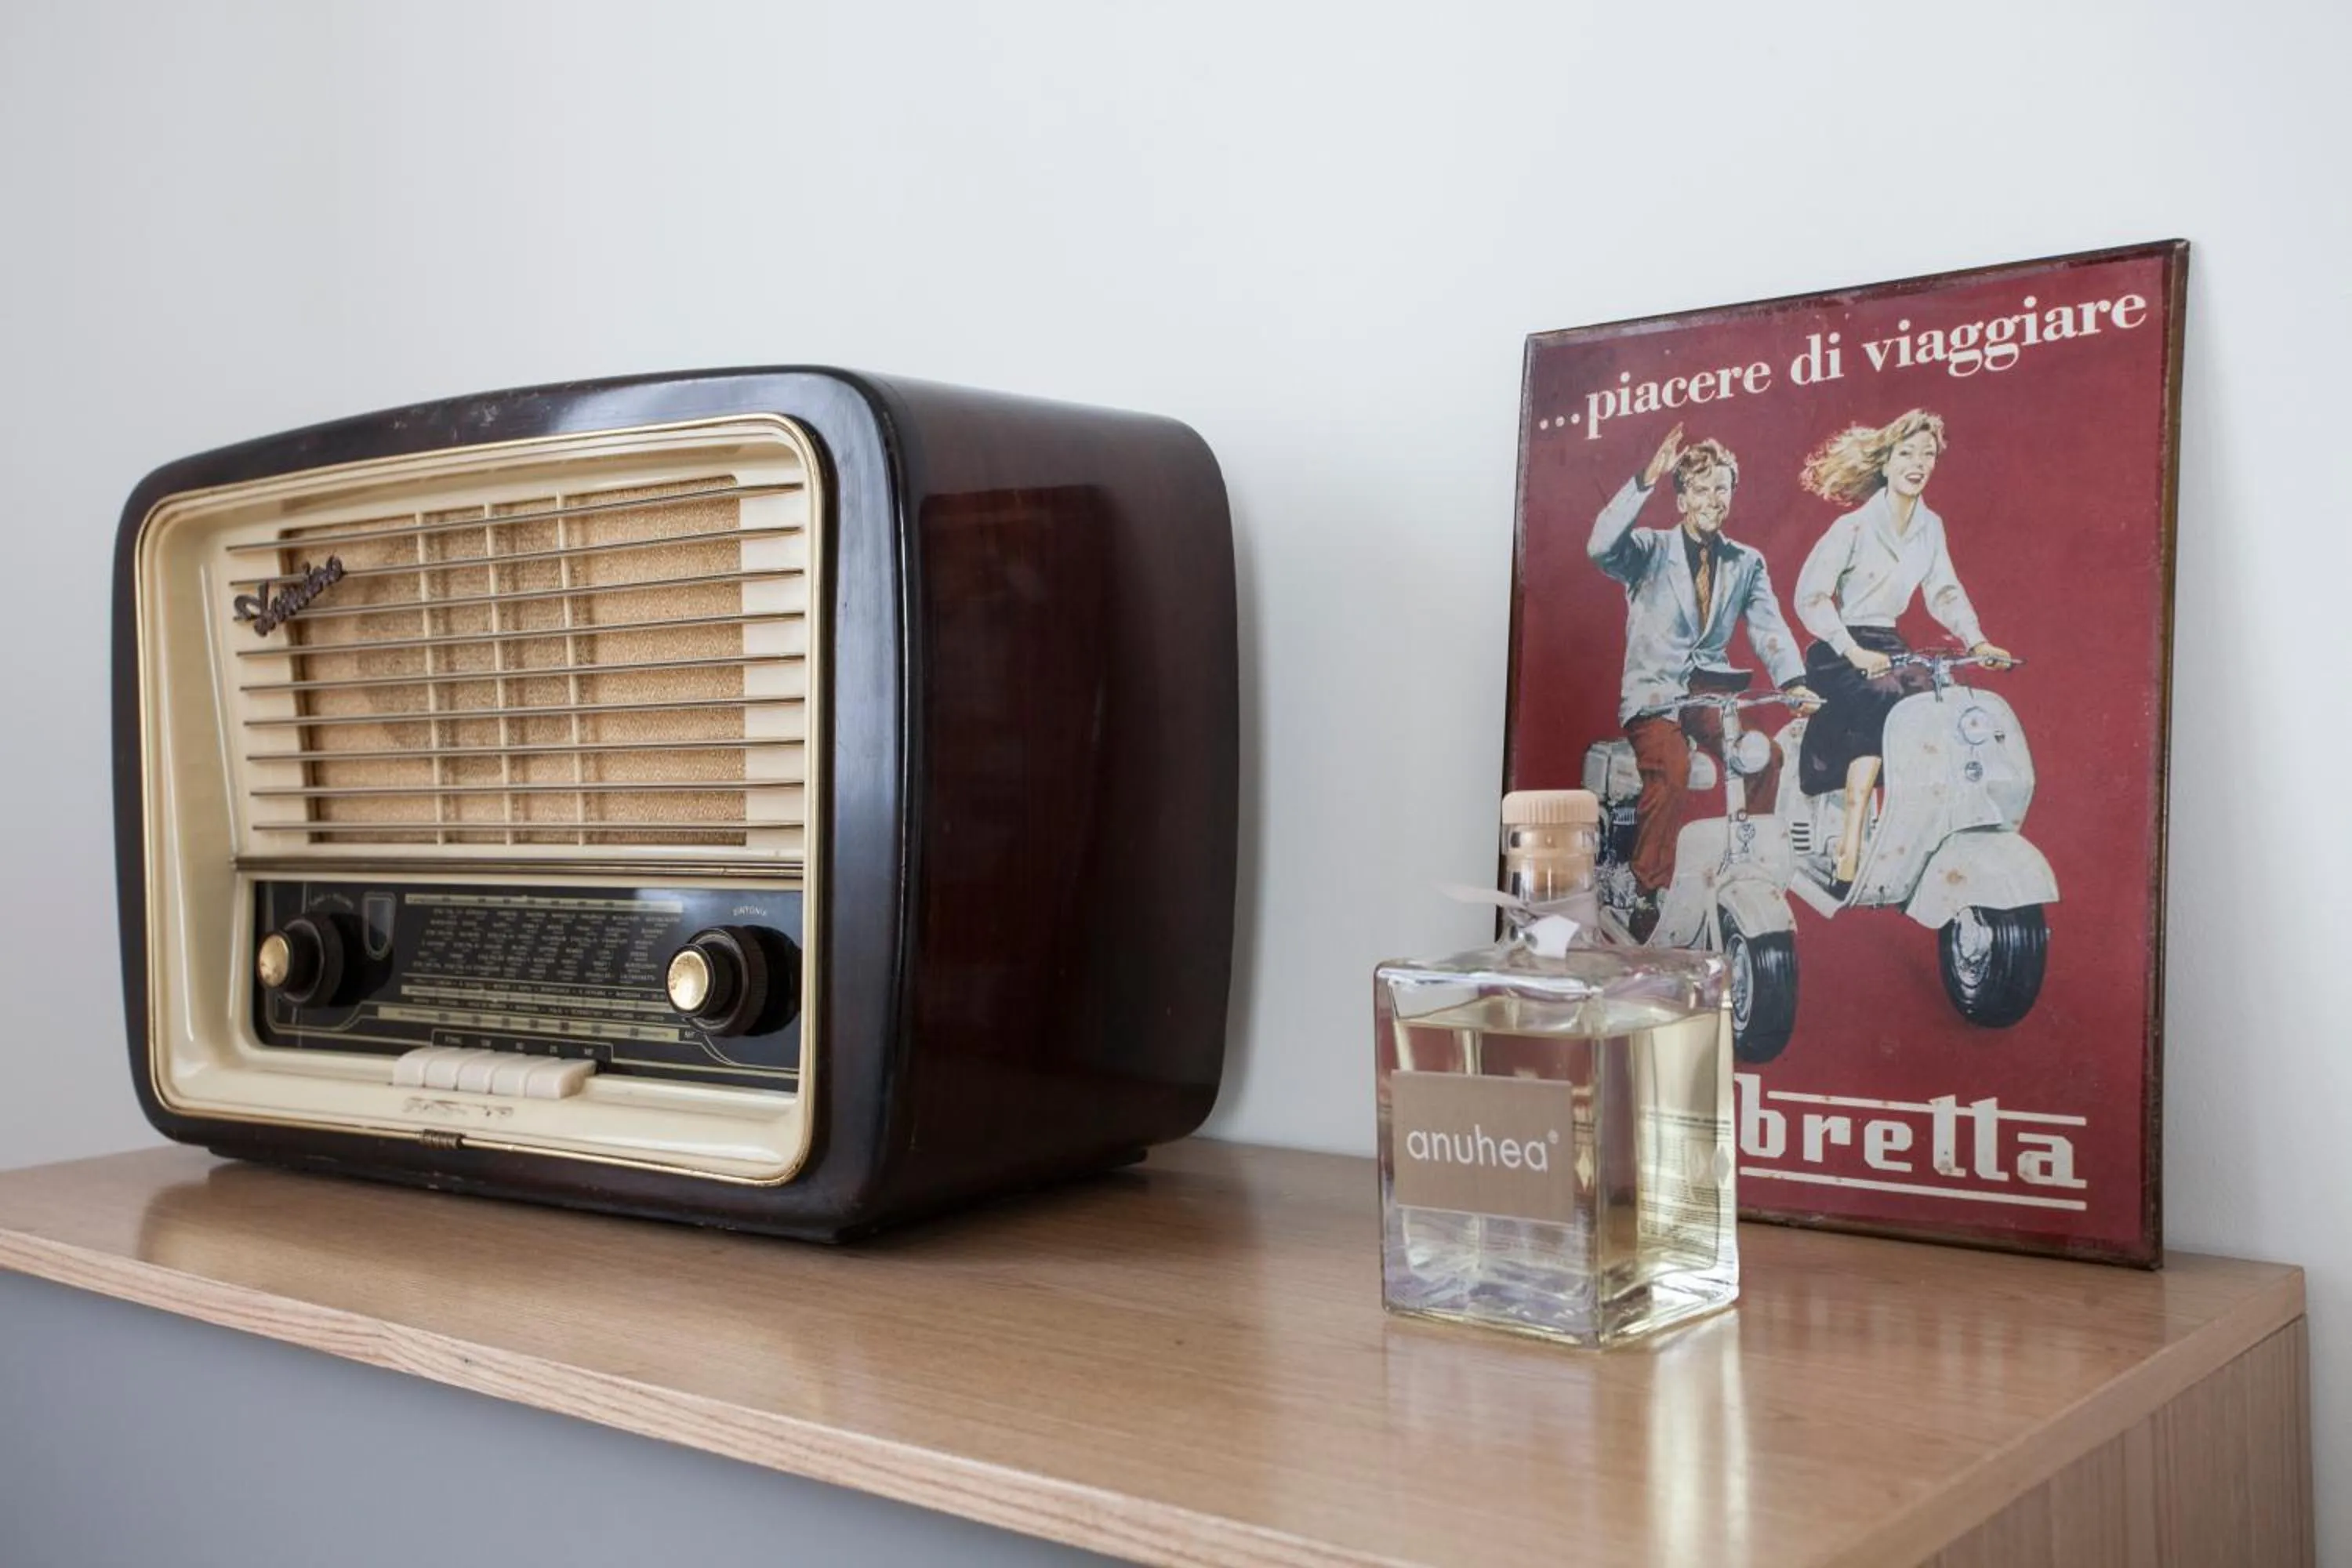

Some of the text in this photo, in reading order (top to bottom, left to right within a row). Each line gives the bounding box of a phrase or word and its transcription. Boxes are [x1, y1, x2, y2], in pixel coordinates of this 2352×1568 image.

[1790, 332, 1846, 385] di
[1862, 293, 2147, 378] viaggiare
[1733, 1073, 2087, 1189] bretta
